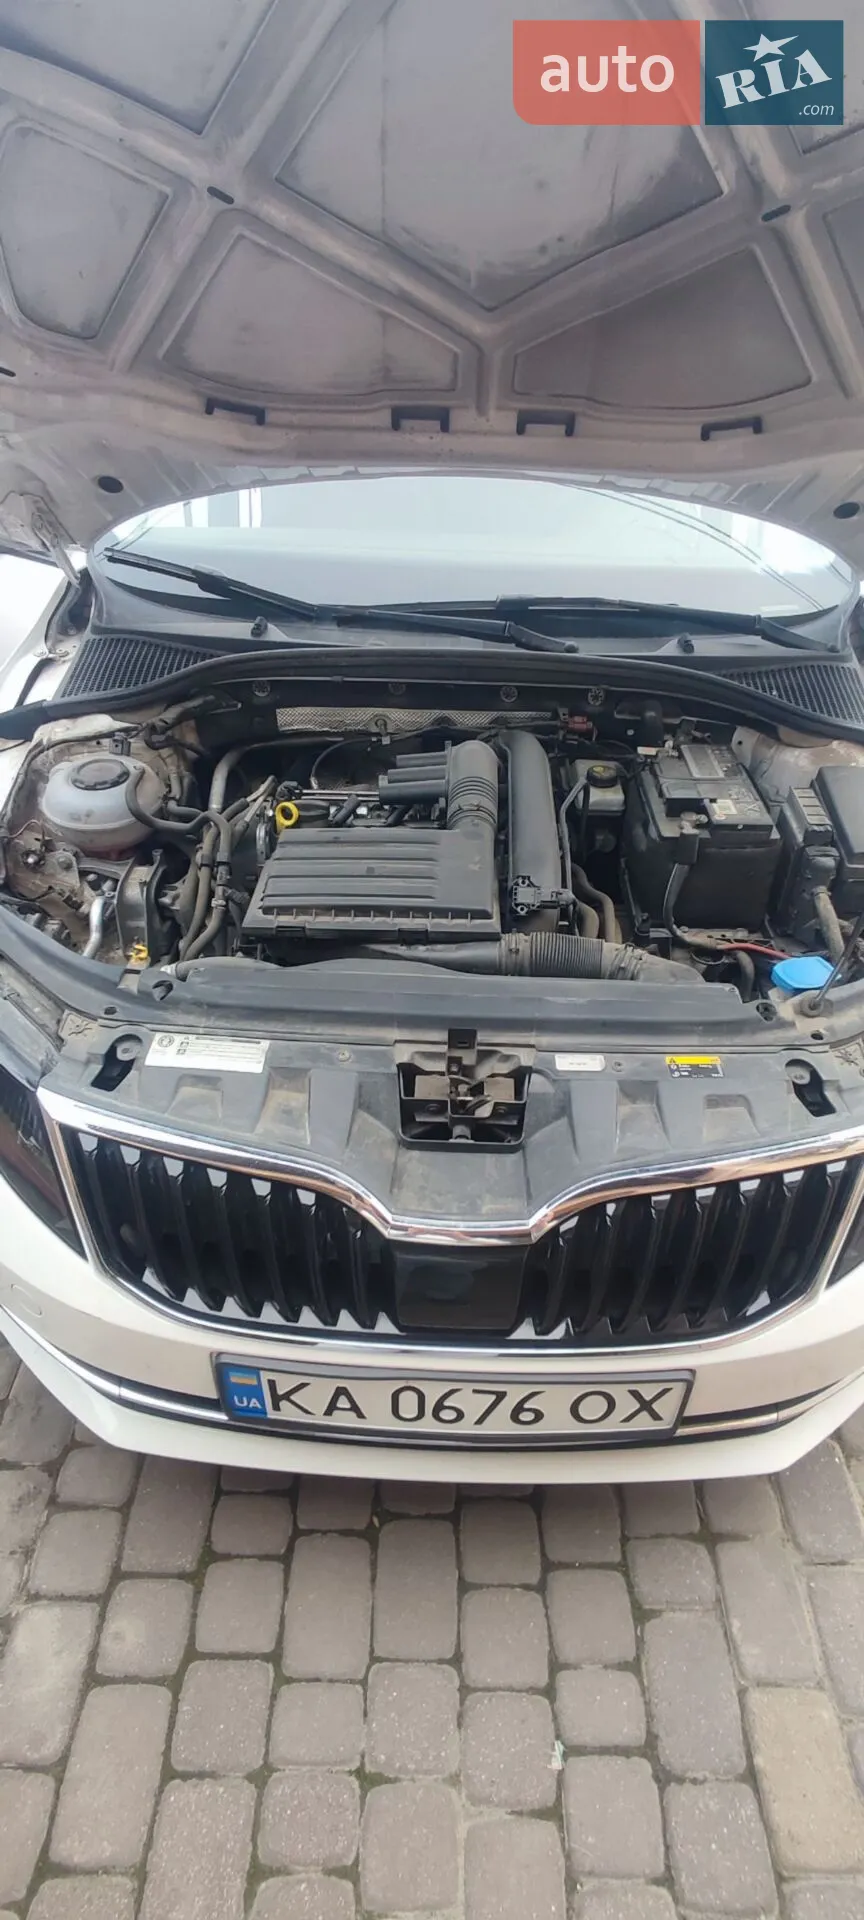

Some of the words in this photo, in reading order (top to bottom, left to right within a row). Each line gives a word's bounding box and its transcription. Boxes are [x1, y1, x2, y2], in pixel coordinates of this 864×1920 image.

[235, 1397, 262, 1410] UA
[267, 1378, 367, 1420] KA
[391, 1385, 546, 1426] 0676
[569, 1387, 674, 1425] OX
